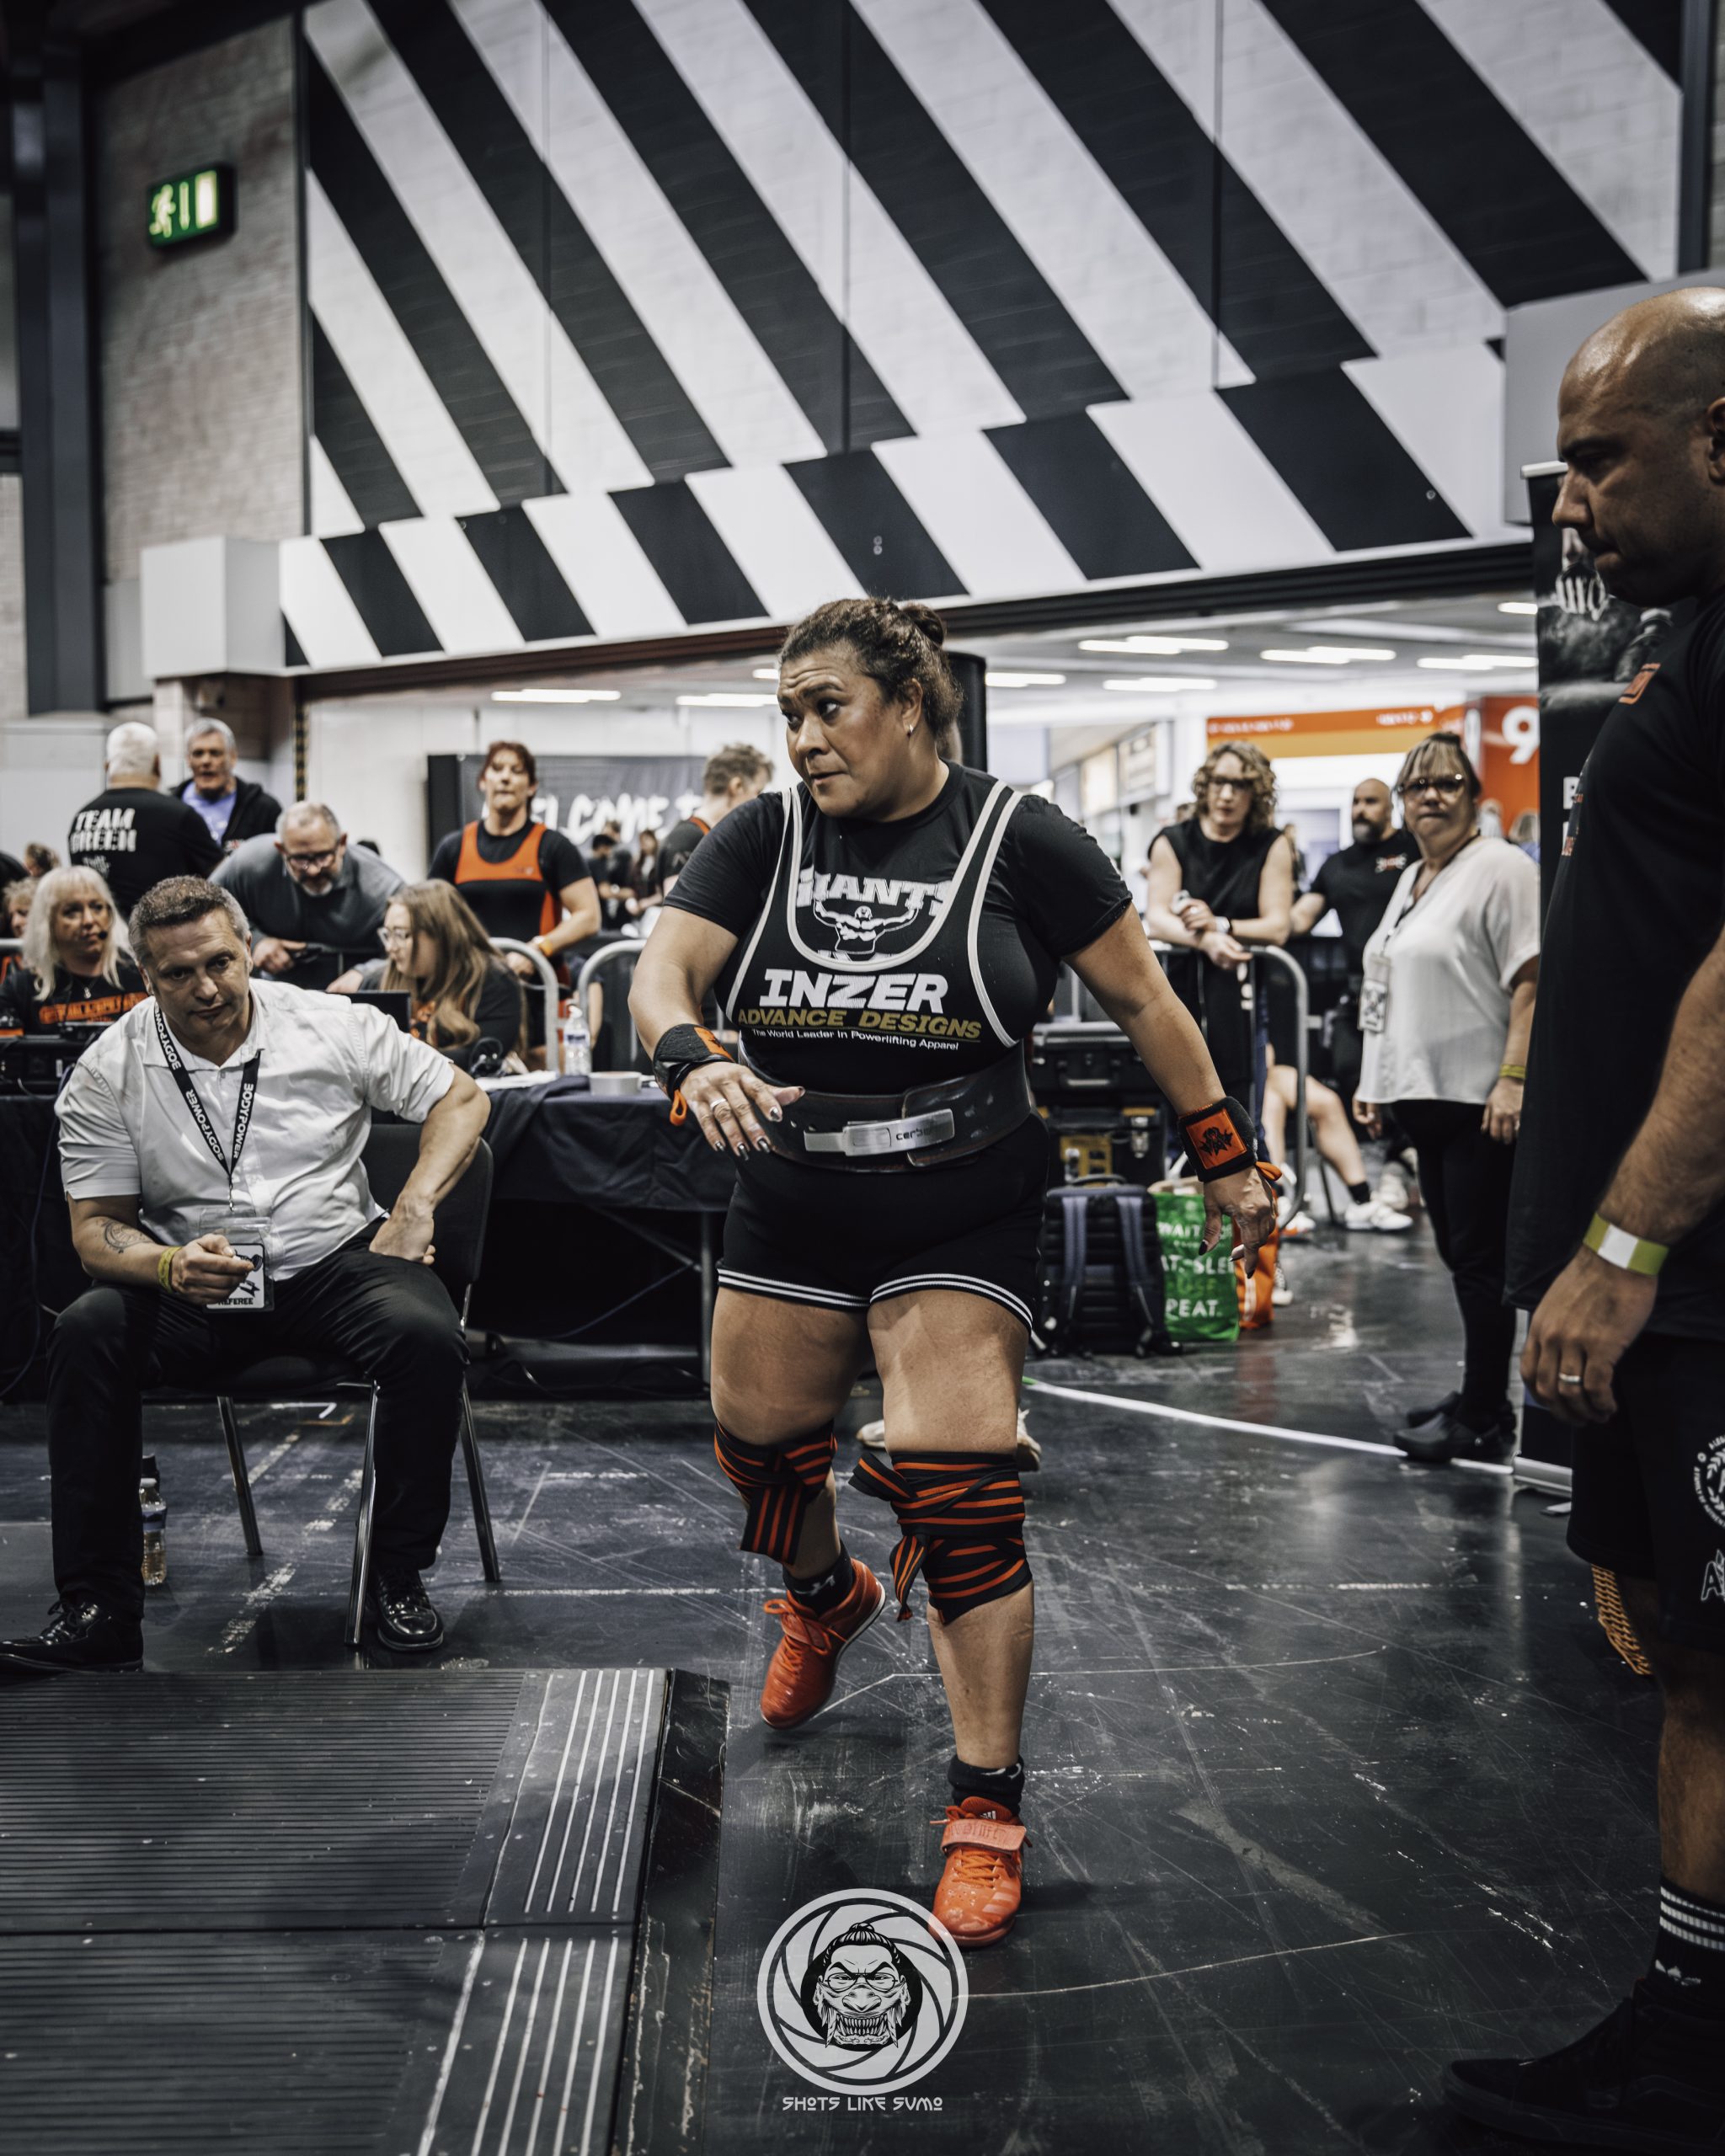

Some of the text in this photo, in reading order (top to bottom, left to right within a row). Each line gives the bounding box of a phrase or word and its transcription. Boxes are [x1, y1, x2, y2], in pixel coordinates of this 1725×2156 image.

[1502, 706, 1540, 765] 9
[71, 829, 136, 854] GREEN
[75, 808, 136, 831] TEAM
[759, 969, 948, 1013] INZER
[154, 1002, 182, 1071] BODYPOWE
[738, 1008, 982, 1038] ADVANCE DESIGNS
[752, 1028, 766, 1037] The
[766, 1029, 794, 1038] World
[796, 1030, 835, 1038] Leader
[851, 1031, 916, 1048] Powerlifting
[919, 1039, 959, 1051] Apparel
[185, 1088, 224, 1161] BODYPOWER
[232, 1082, 254, 1160] BODYPOWER
